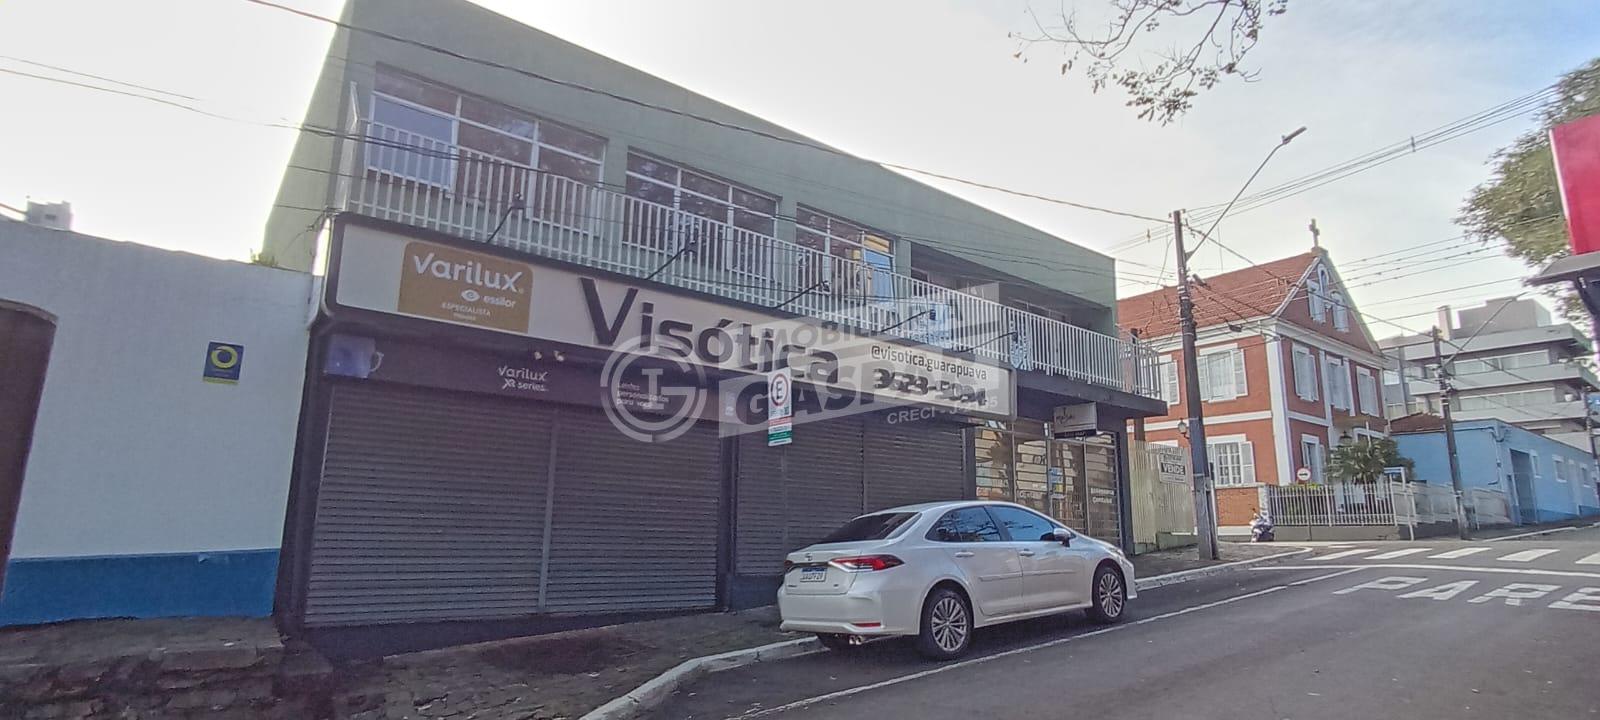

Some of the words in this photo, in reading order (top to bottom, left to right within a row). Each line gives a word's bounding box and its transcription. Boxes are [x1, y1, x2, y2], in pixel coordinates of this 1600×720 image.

[412, 252, 523, 293] Varilux
[580, 277, 840, 384] Visótica
[498, 365, 548, 381] Varilux
[871, 345, 987, 380] @visotica.guarapuava
[775, 380, 783, 400] E
[1333, 576, 1600, 612] PARE
